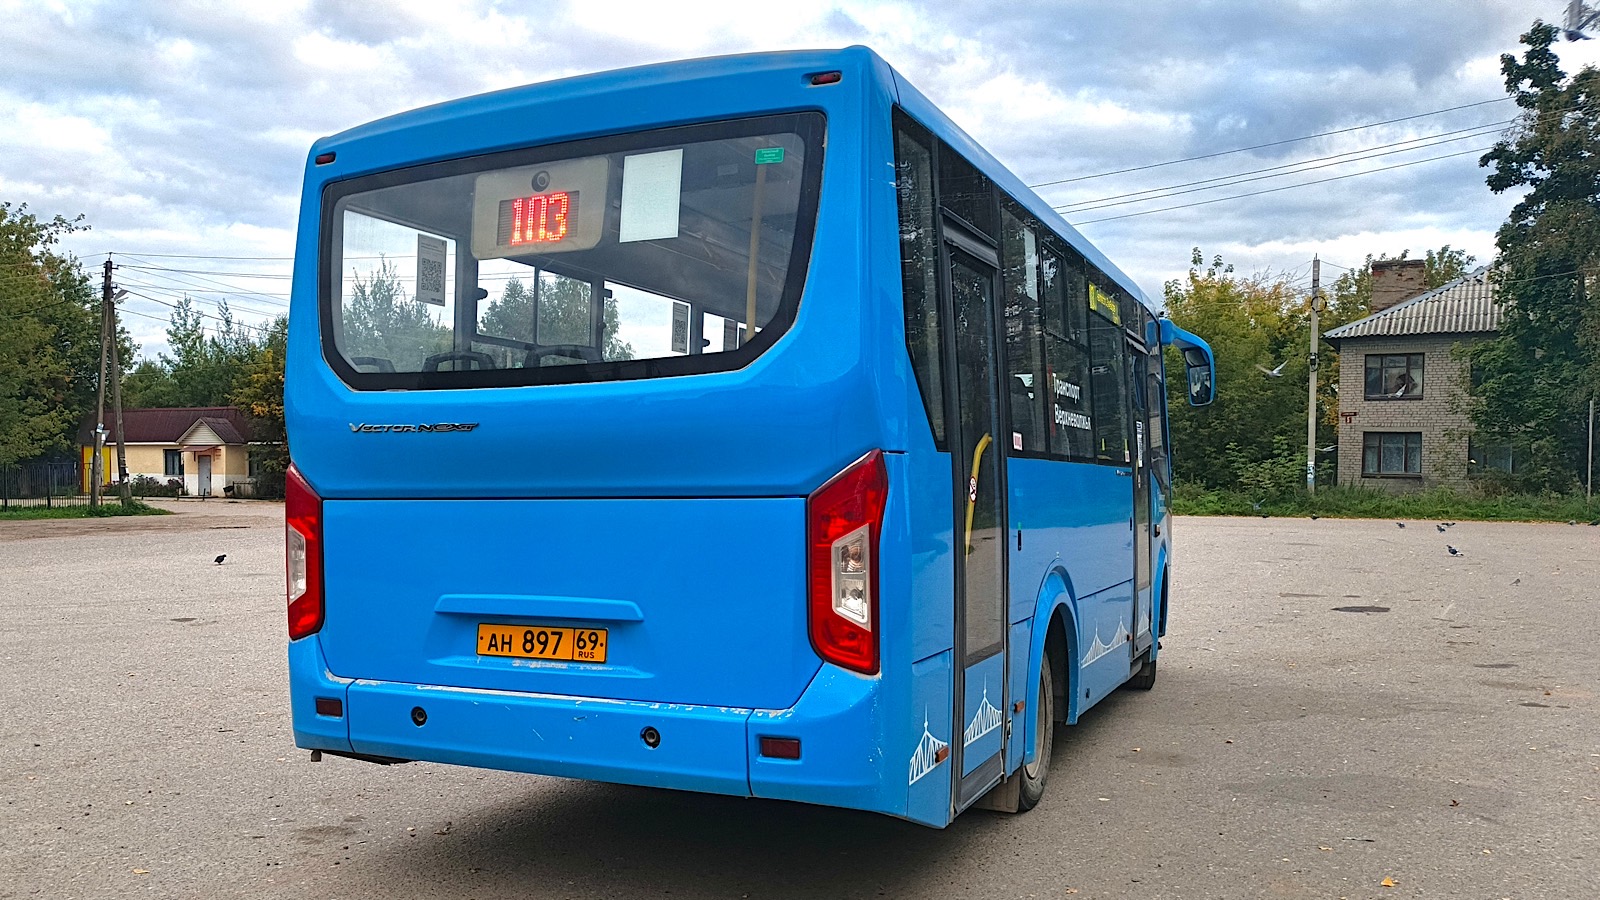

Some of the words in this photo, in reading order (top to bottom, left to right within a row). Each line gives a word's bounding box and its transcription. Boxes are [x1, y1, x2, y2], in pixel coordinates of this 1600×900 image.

[1052, 372, 1080, 404] Транспорт
[522, 629, 563, 656] 897
[576, 631, 599, 651] 69
[578, 651, 595, 659] RUS
